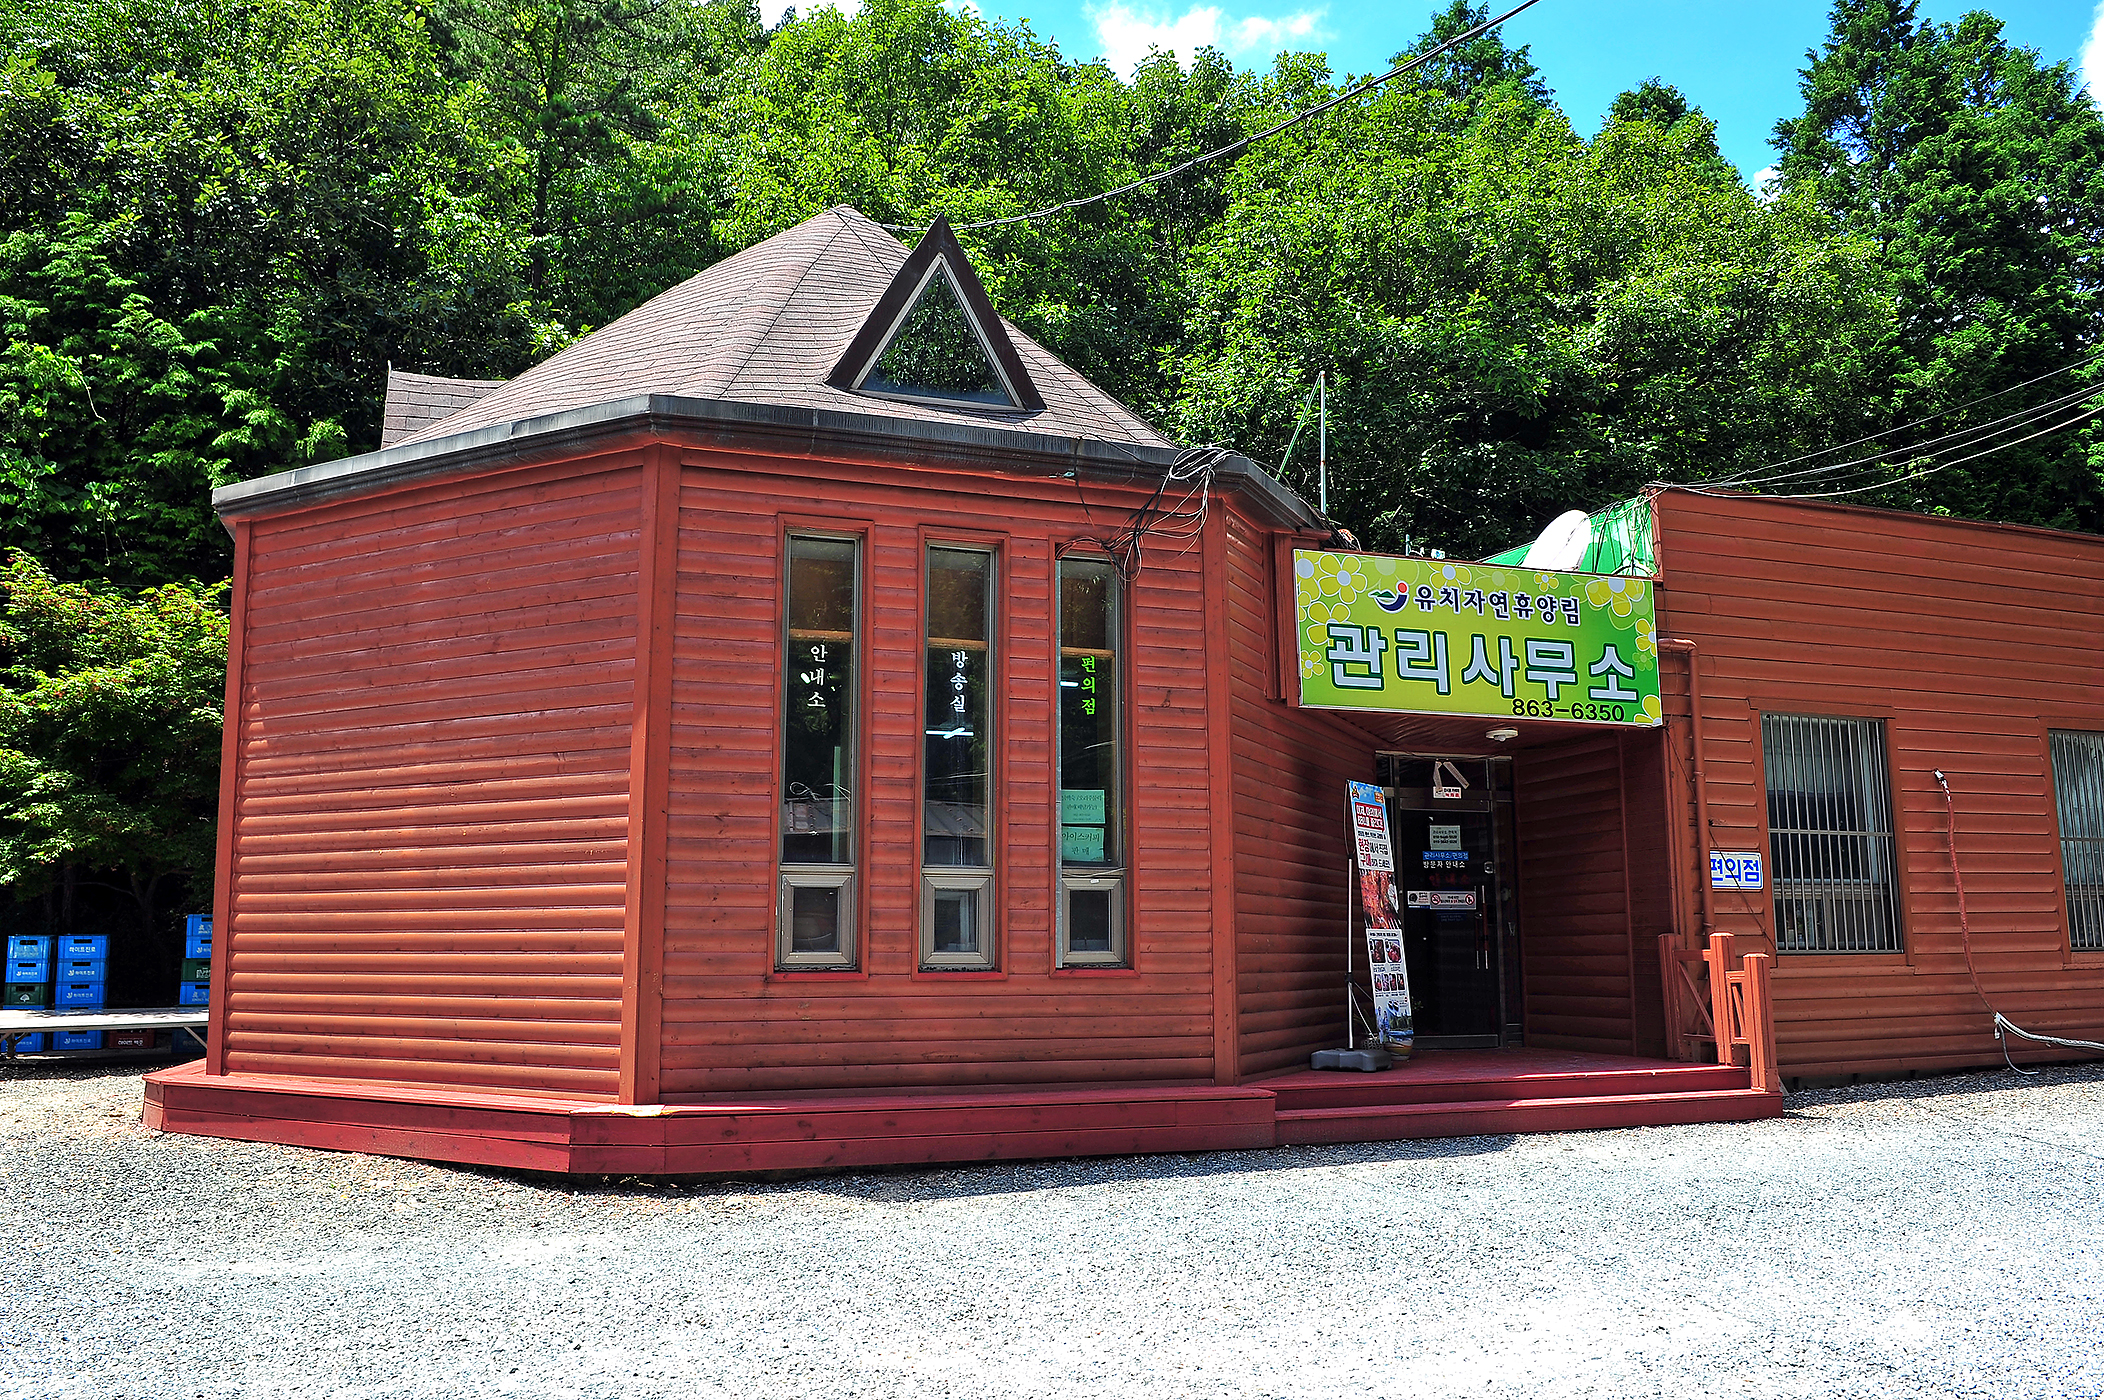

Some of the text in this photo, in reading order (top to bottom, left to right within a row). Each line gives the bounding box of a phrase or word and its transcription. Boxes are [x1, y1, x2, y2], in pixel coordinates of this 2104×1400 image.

[1414, 586, 1580, 625] 유치자연휴양림
[807, 643, 828, 709] 안내소
[949, 650, 968, 713] 방송실
[1327, 624, 1639, 702] 관리사무소
[1081, 655, 1097, 716] 편의점
[1512, 700, 1625, 722] 863-6350
[1062, 831, 1100, 842] 아이스커피
[1445, 860, 1465, 869] 안내소
[1710, 858, 1760, 882] 편의점
